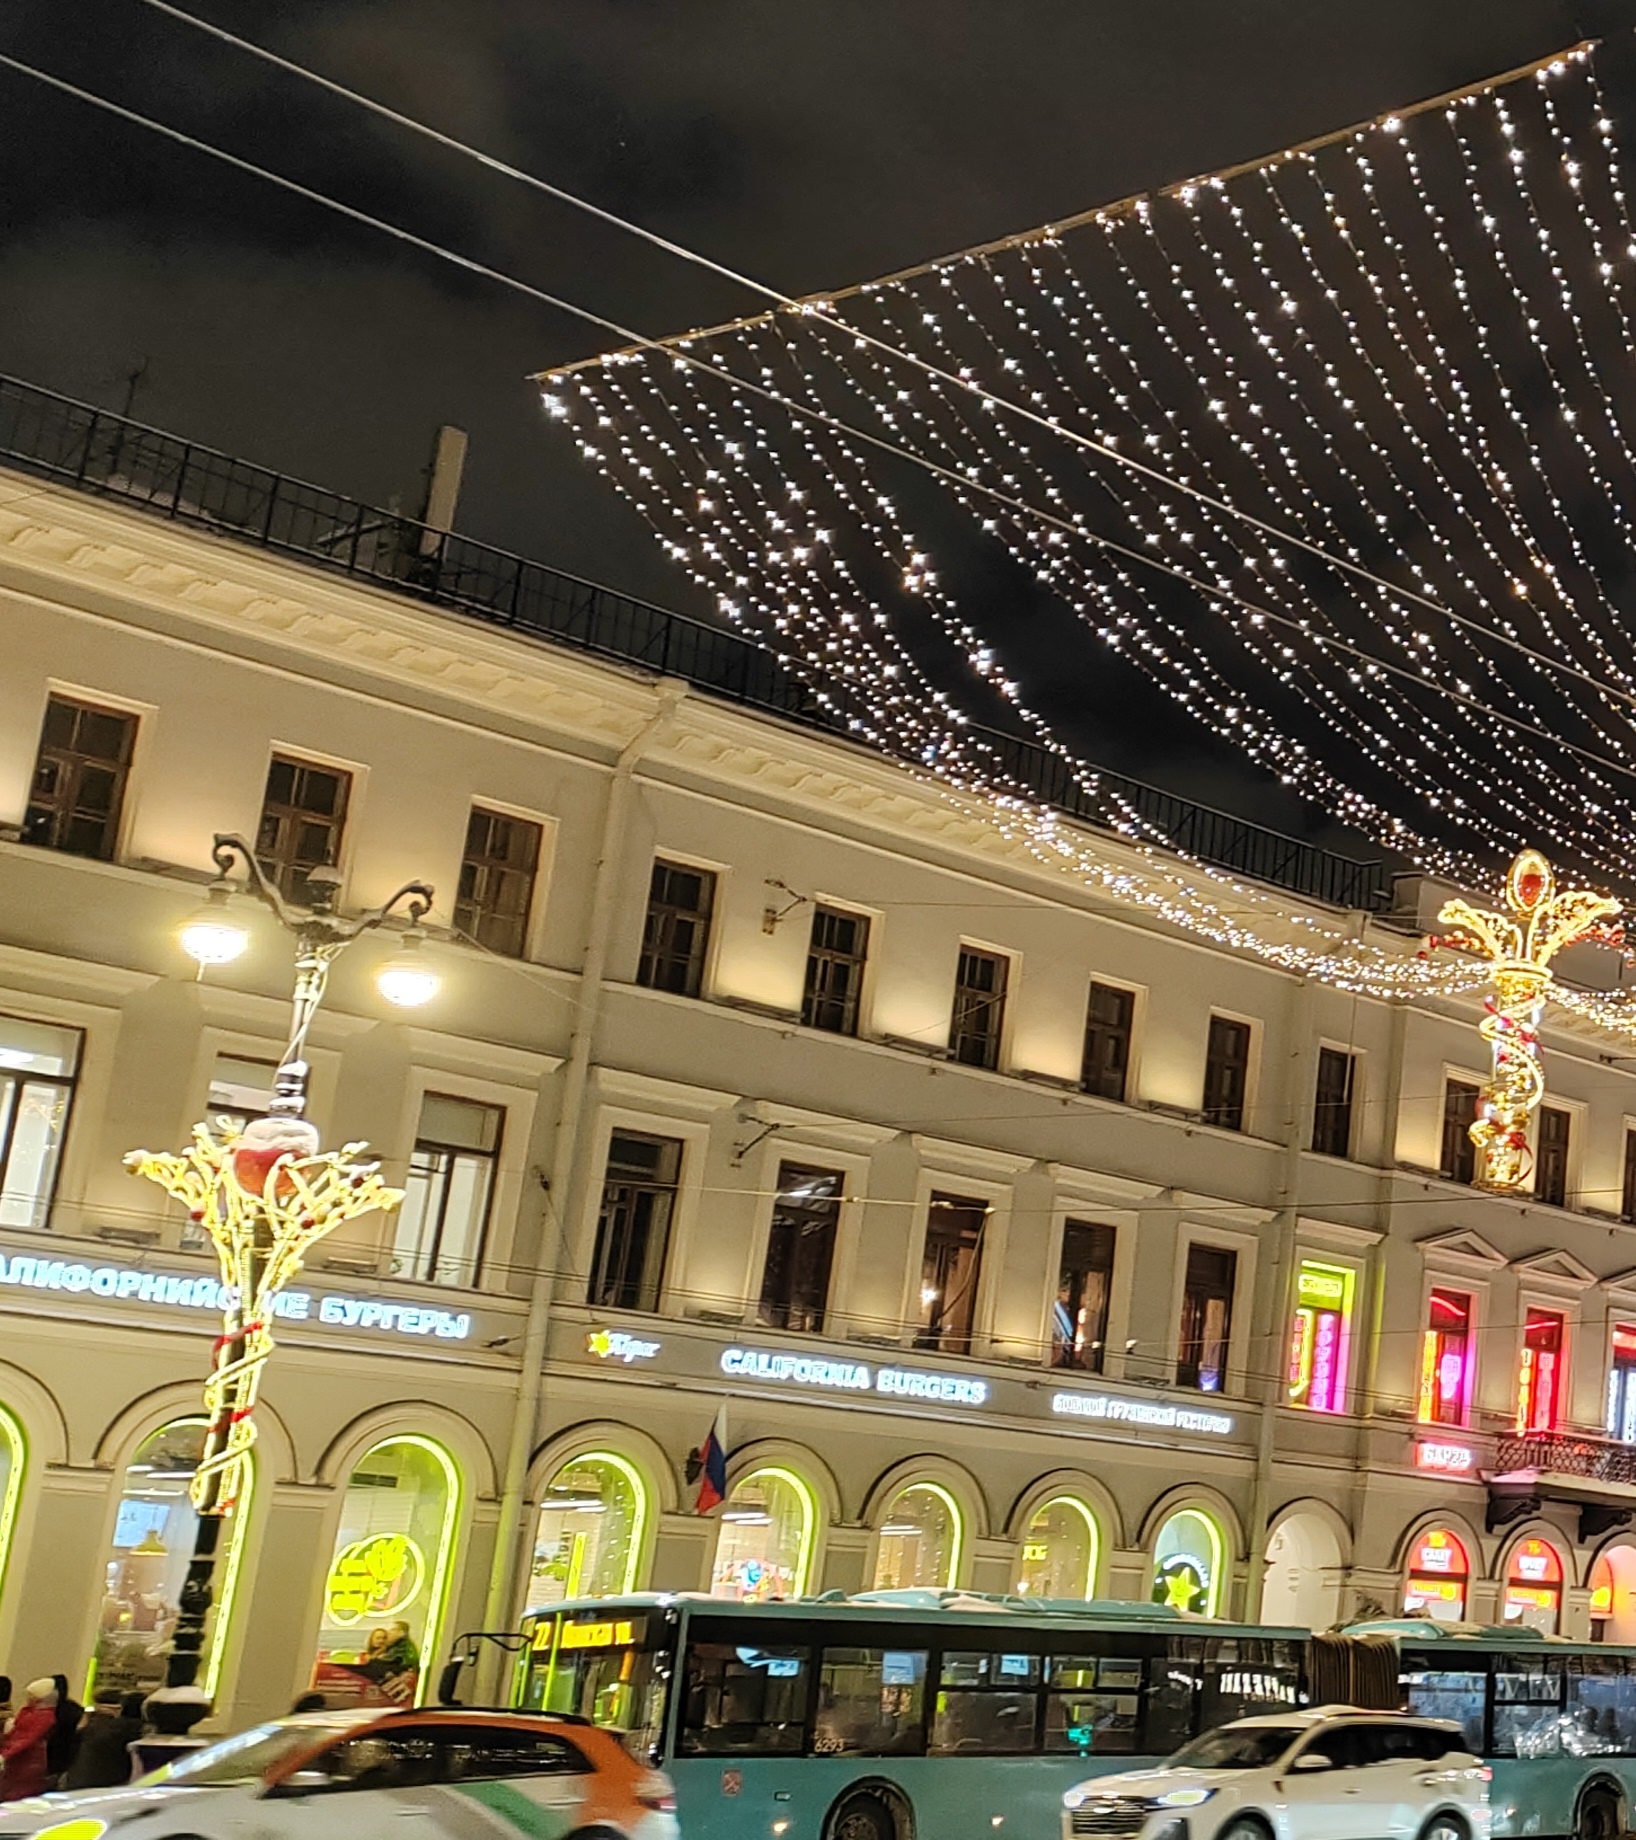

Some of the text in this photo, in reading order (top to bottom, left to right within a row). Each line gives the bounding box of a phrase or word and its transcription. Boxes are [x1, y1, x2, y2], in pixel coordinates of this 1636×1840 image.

[0, 1254, 470, 1339] ЛИФОРНИЙСИЕ БУРГЕРЫ
[720, 1350, 987, 1404] CALIFORNIA BURGERS
[532, 1621, 551, 1651] 22
[814, 1738, 845, 1753] 6293
